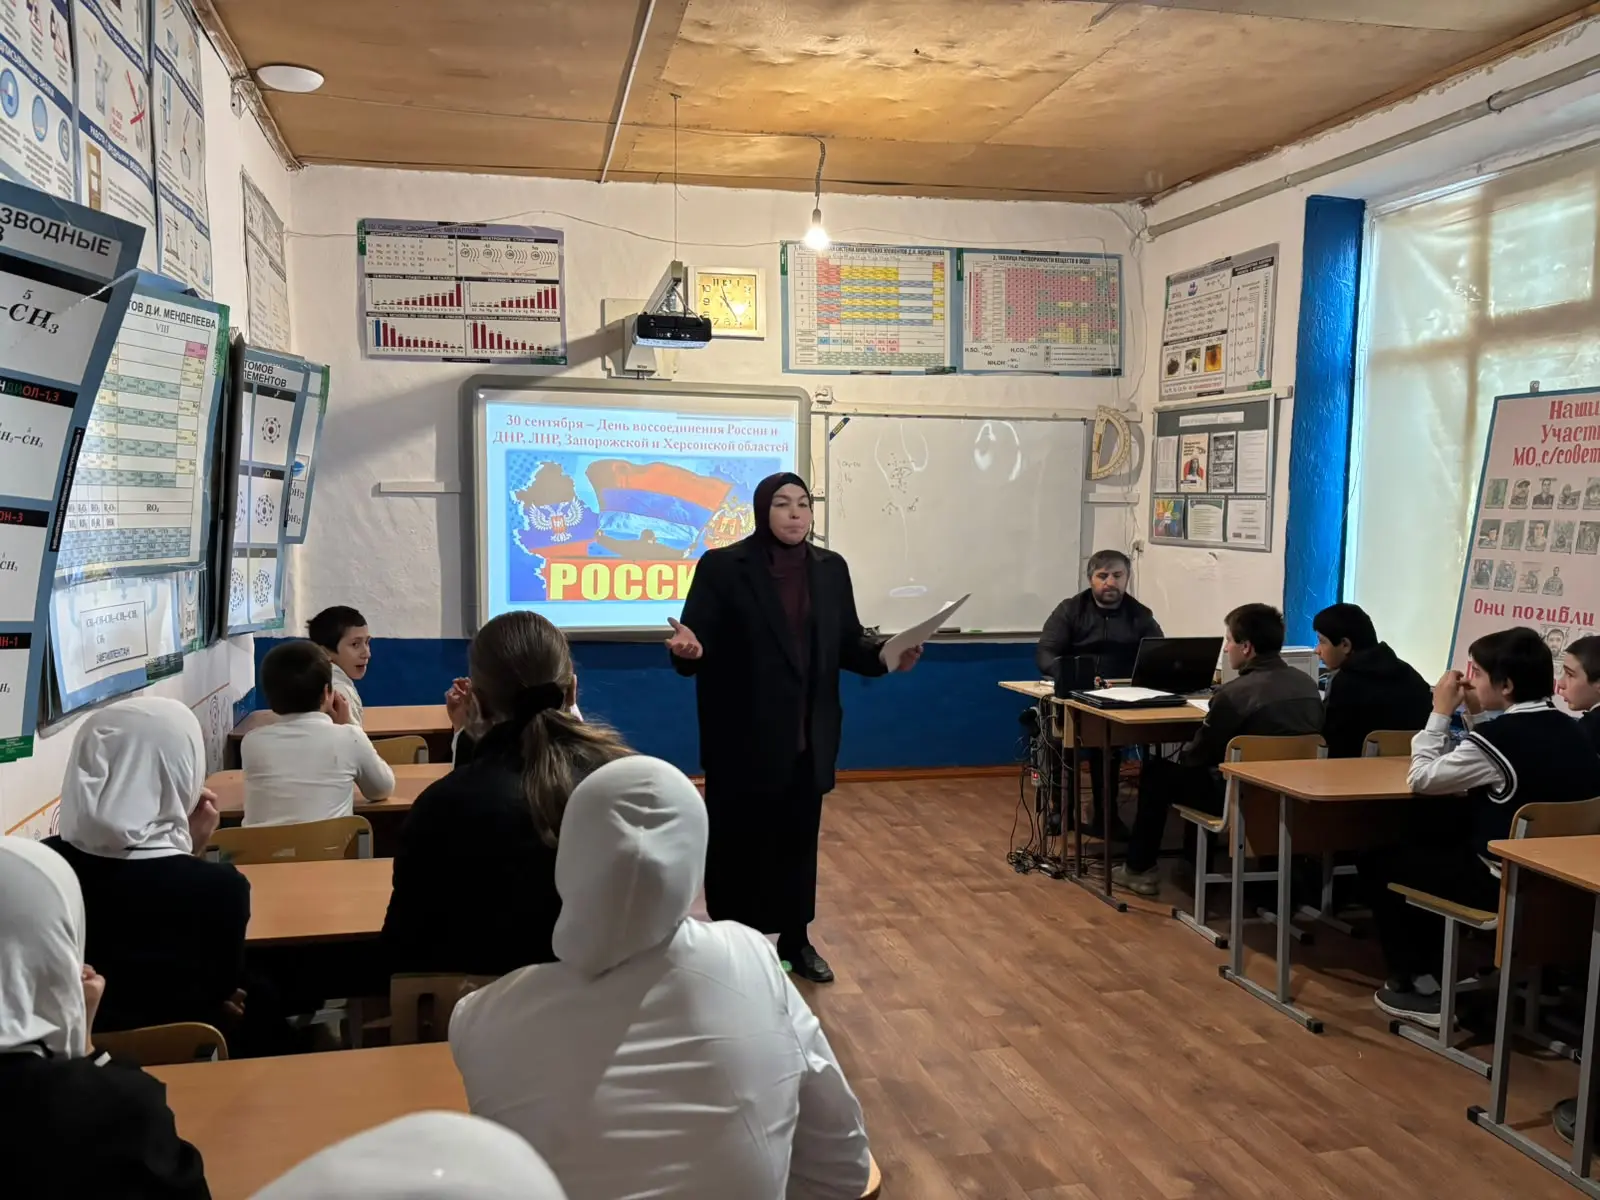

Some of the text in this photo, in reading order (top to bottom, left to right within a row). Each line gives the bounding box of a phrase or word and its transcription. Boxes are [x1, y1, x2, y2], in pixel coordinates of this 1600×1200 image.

[713, 279, 719, 287] 11
[129, 301, 143, 312] ОВ
[163, 308, 216, 329] МЕНДЕЛЕЕВА
[713, 318, 719, 326] 7
[156, 323, 170, 334] VIII
[506, 415, 521, 426] 30
[524, 417, 583, 431] сентября
[597, 419, 630, 431] День
[633, 422, 724, 435] воссоединения
[727, 424, 768, 436] России
[770, 427, 778, 436] и
[566, 433, 649, 449] Запорожской
[652, 440, 660, 449] и
[663, 438, 735, 452] Херсонской
[737, 441, 789, 452] областей
[1474, 598, 1505, 616] Они
[1512, 605, 1595, 626] погибли
